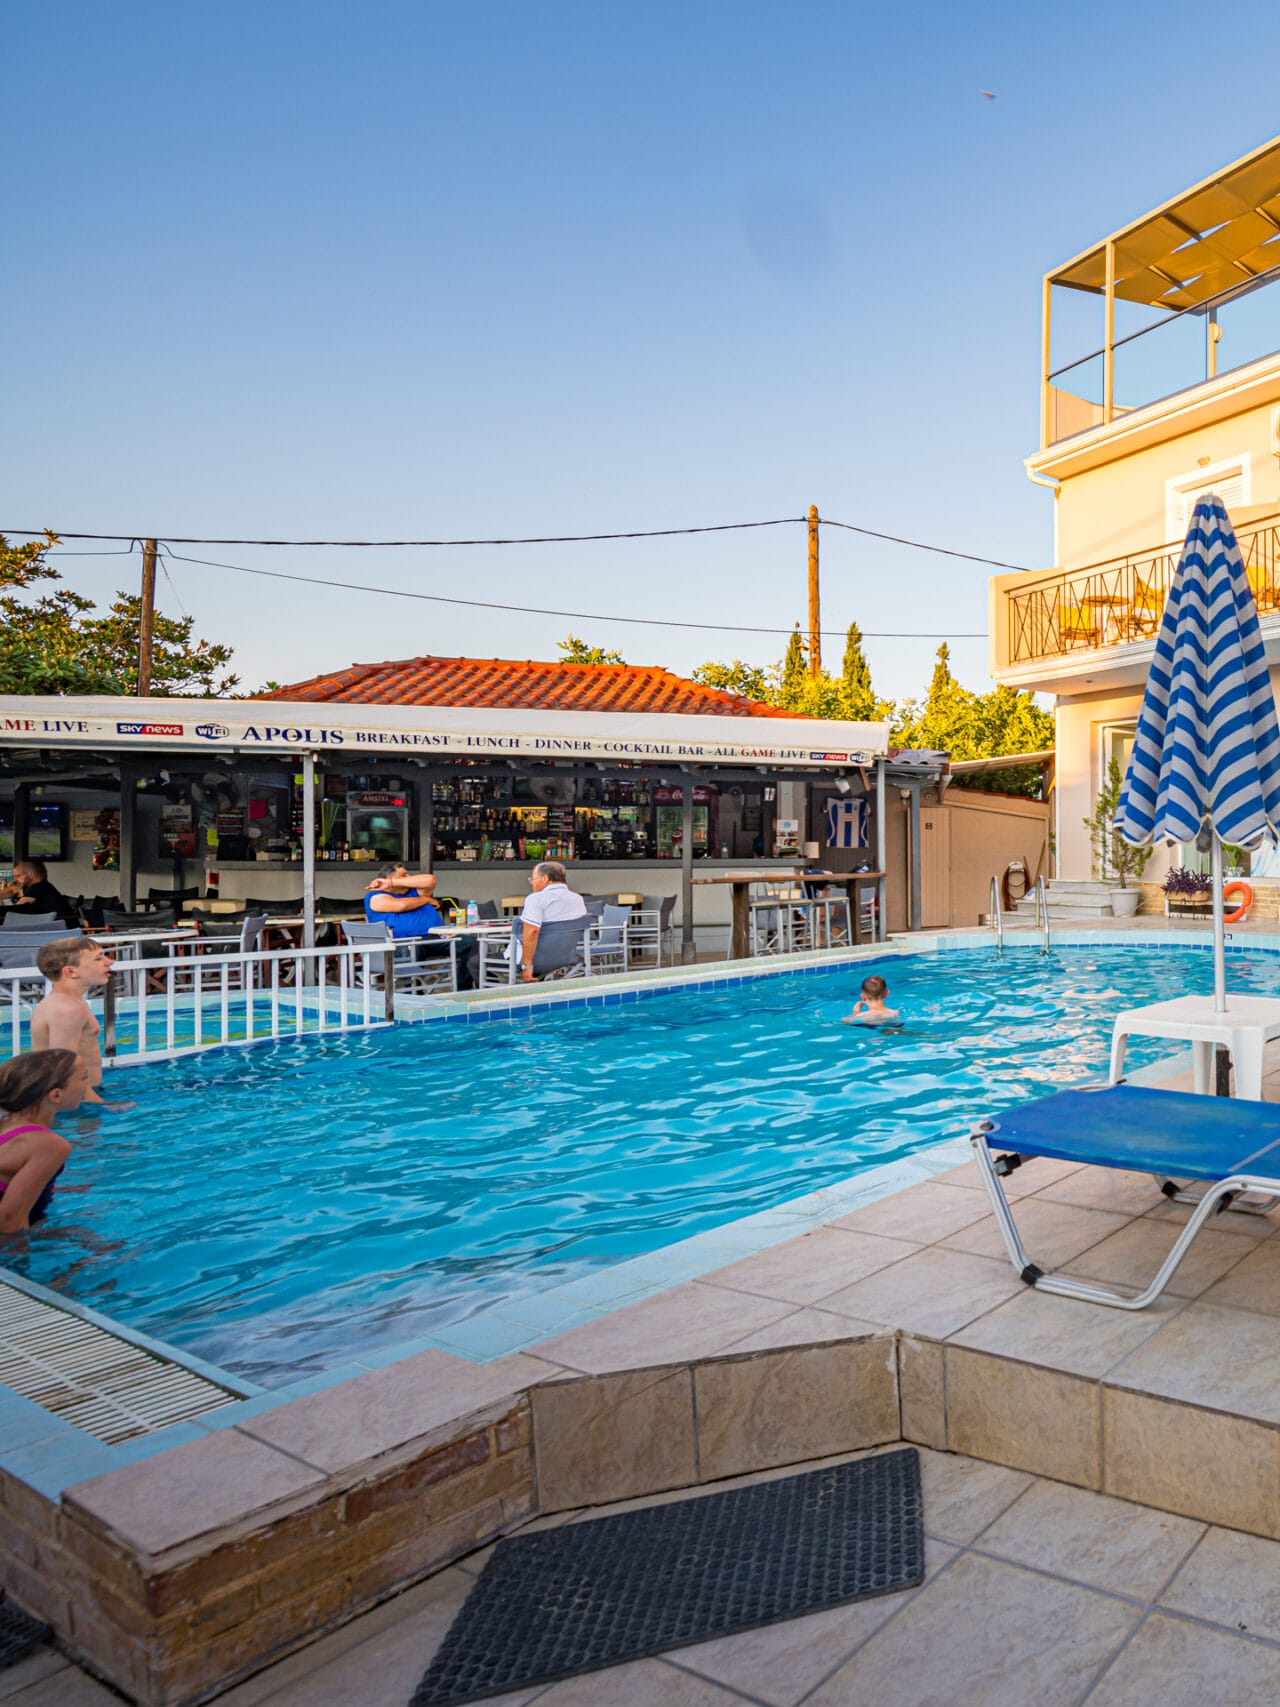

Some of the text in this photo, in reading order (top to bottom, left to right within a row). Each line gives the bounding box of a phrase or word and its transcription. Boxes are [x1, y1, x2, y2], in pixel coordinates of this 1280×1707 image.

[0, 719, 36, 731] ME
[43, 720, 89, 732] LIVE
[145, 725, 181, 734] news
[241, 726, 344, 744] APOLIS
[356, 732, 450, 746] BREAKFAST
[467, 736, 520, 748] LUNCH
[535, 738, 592, 751] DINNER
[603, 742, 673, 754] COCKTAIL
[678, 745, 704, 755] BAR
[714, 747, 737, 757] ALL
[740, 748, 776, 758] GAME
[780, 749, 806, 759] LIVE
